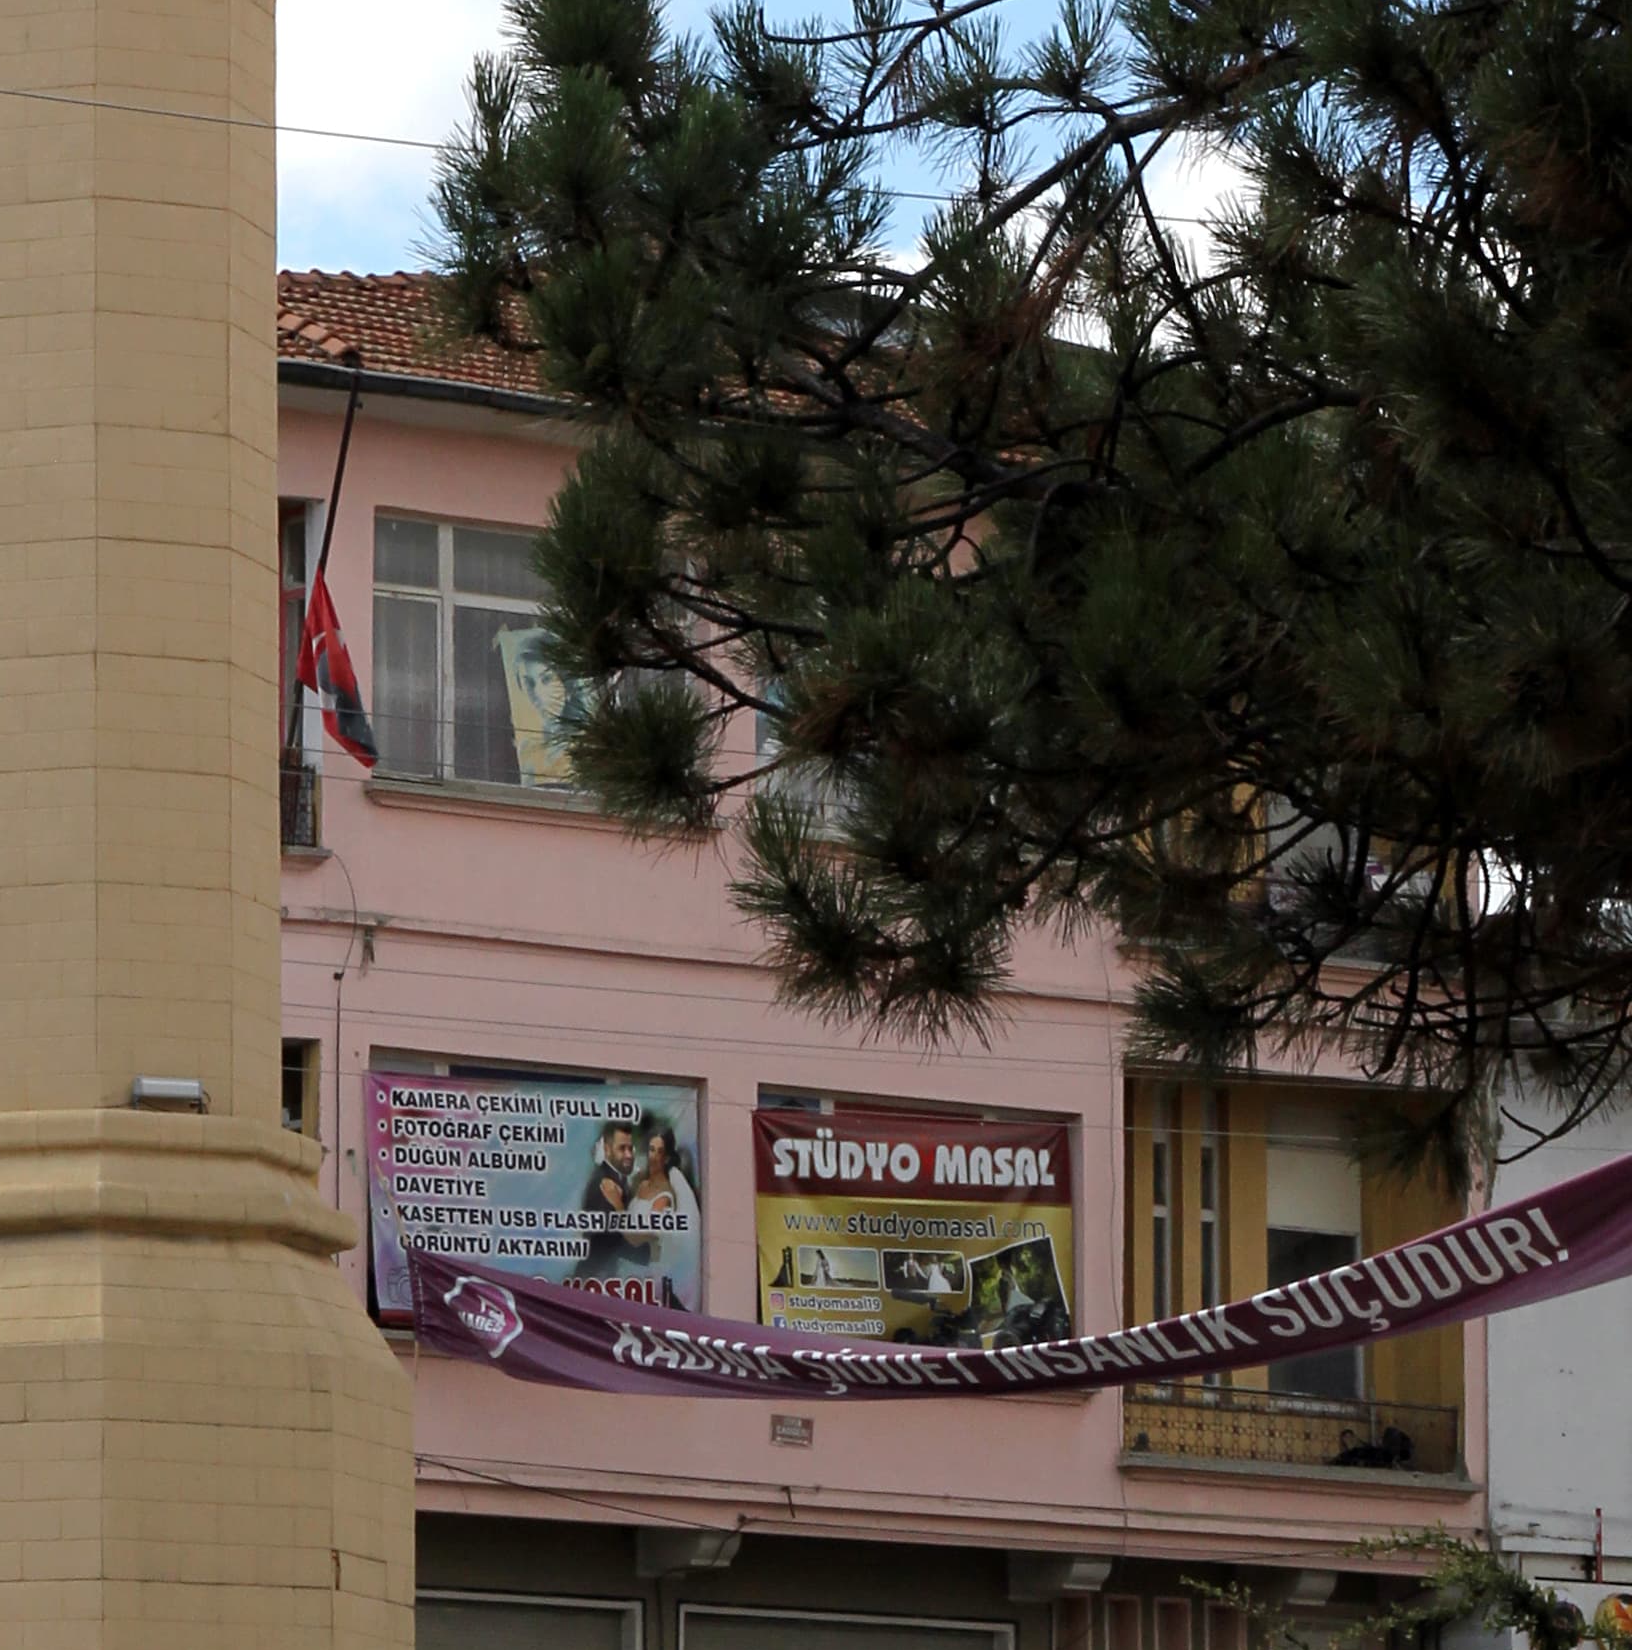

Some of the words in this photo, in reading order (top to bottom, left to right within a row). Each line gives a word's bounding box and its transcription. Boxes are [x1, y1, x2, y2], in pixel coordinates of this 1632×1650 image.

[391, 1090, 470, 1110] KAMERA
[477, 1093, 543, 1118] ÇEKİMİ
[550, 1100, 601, 1119] (FULL
[607, 1102, 640, 1121] HD)
[394, 1117, 492, 1140] FOTOĞRAF
[499, 1122, 565, 1148] ÇEKİMİ
[395, 1145, 461, 1167] DÜĞÜN
[468, 1149, 546, 1171] ALBÜMÜ
[773, 1128, 920, 1183] STÜDYO
[933, 1144, 1055, 1187] MASAL
[396, 1175, 486, 1197] DAVETİYE
[398, 1204, 493, 1226] KASETTEN
[499, 1210, 537, 1228] USB
[544, 1212, 604, 1230] FLASH
[608, 1210, 688, 1231] BELLEĞE
[400, 1232, 490, 1254] GÖRÜNTÜ
[497, 1240, 588, 1258] AKTARIMI
[1251, 1207, 1569, 1332] SUÇUDUR!
[788, 1296, 881, 1312] studyomasal19
